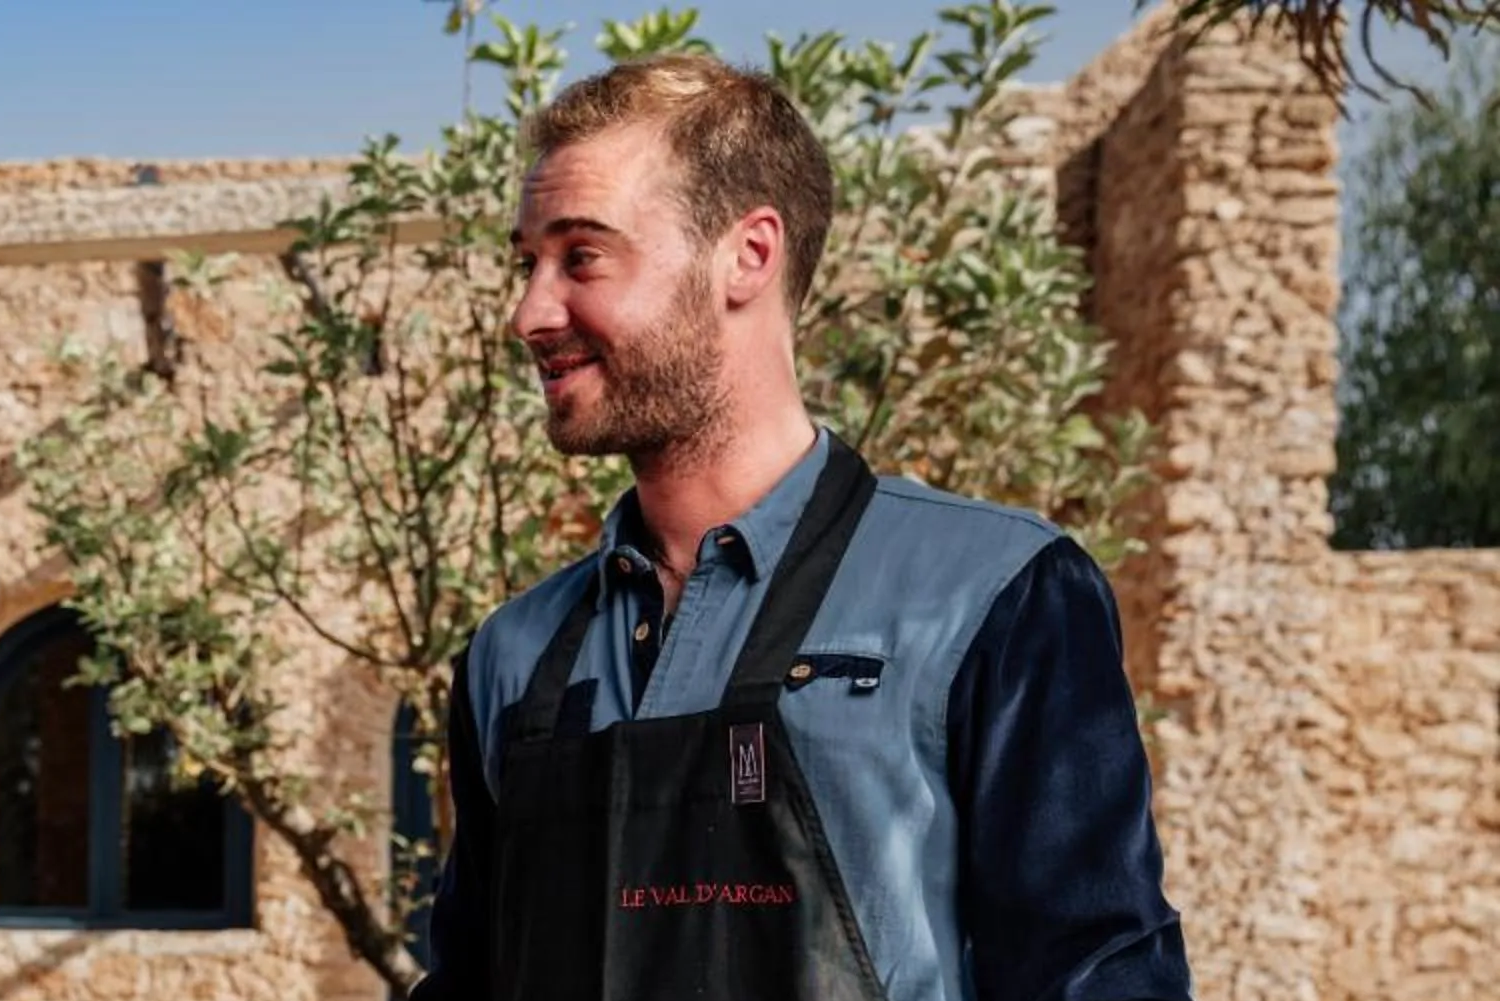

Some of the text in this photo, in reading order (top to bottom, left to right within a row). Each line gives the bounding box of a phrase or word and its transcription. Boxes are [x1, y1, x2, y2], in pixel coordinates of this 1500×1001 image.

[620, 882, 794, 907] LE VAL D'ARGAN
